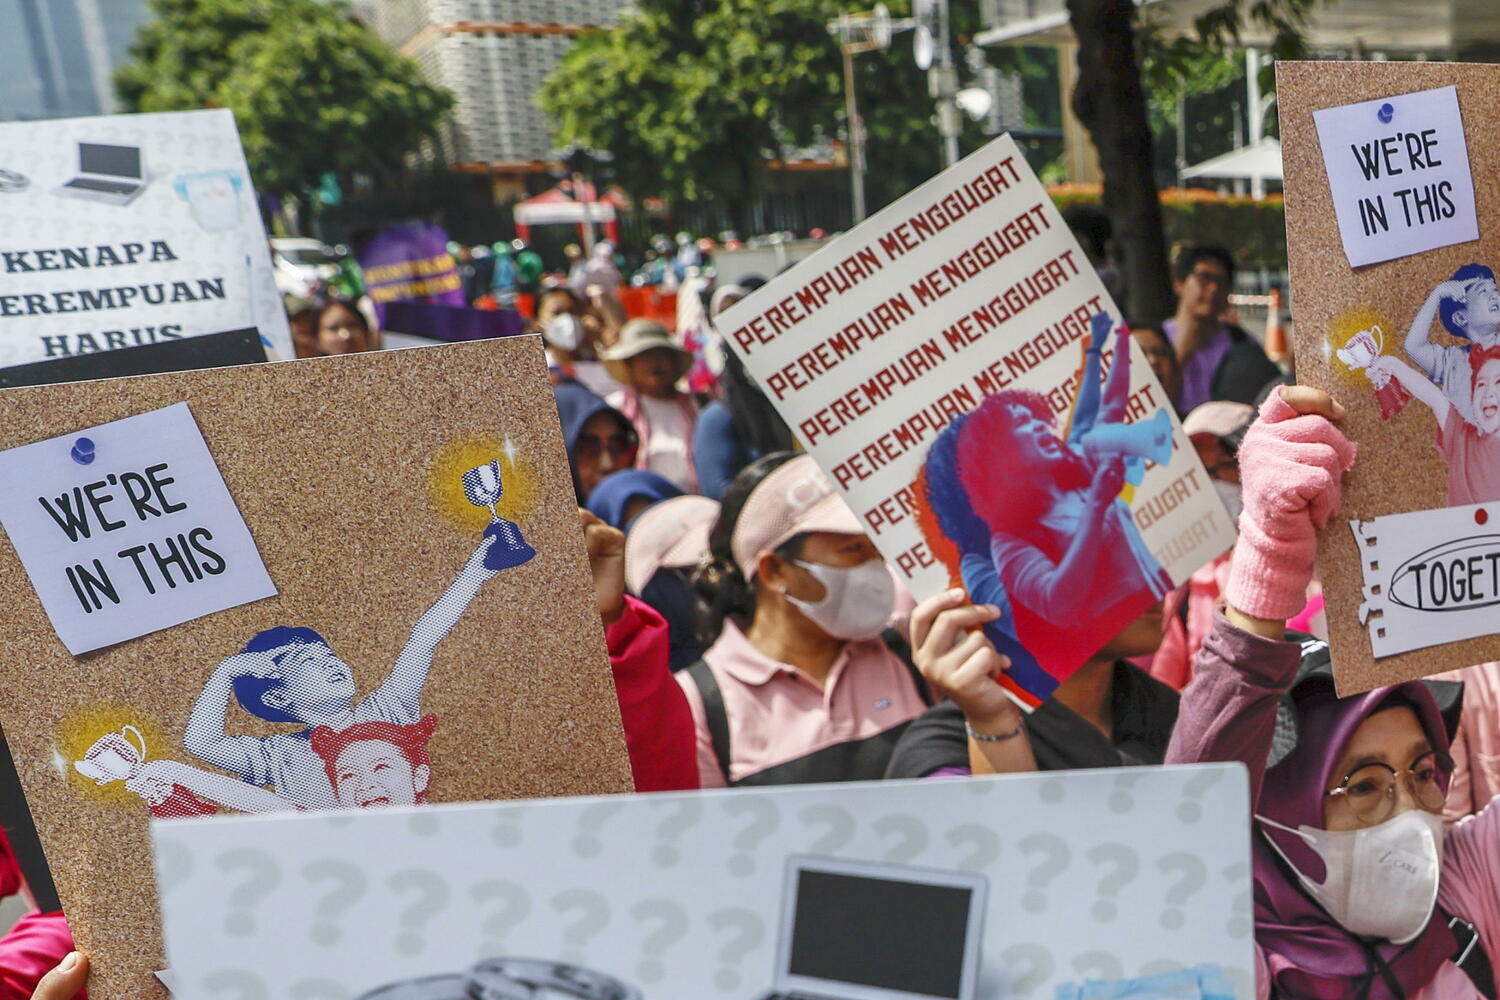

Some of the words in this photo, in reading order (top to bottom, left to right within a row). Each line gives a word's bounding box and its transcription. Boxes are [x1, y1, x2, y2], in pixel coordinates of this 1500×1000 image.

[1350, 128, 1442, 181] WE'RE
[1358, 194, 1389, 237] IN
[1393, 180, 1456, 228] THIS
[1, 240, 178, 274] KENAPA
[732, 245, 883, 355] PEREMPUAN
[877, 156, 1022, 261] MENGGUGAT
[0, 278, 226, 317] EREMPUAN
[765, 292, 914, 401] PEREMPUAN
[909, 203, 1052, 307] MENGGUGAT
[799, 338, 947, 447] PEREMPUAN
[941, 249, 1082, 353] MENGGUGAT
[831, 384, 977, 492] PEREMPUAN
[38, 462, 188, 543] WE'RE
[1133, 467, 1201, 532] GUGAT
[65, 558, 121, 614] IN
[117, 527, 226, 595] THIS
